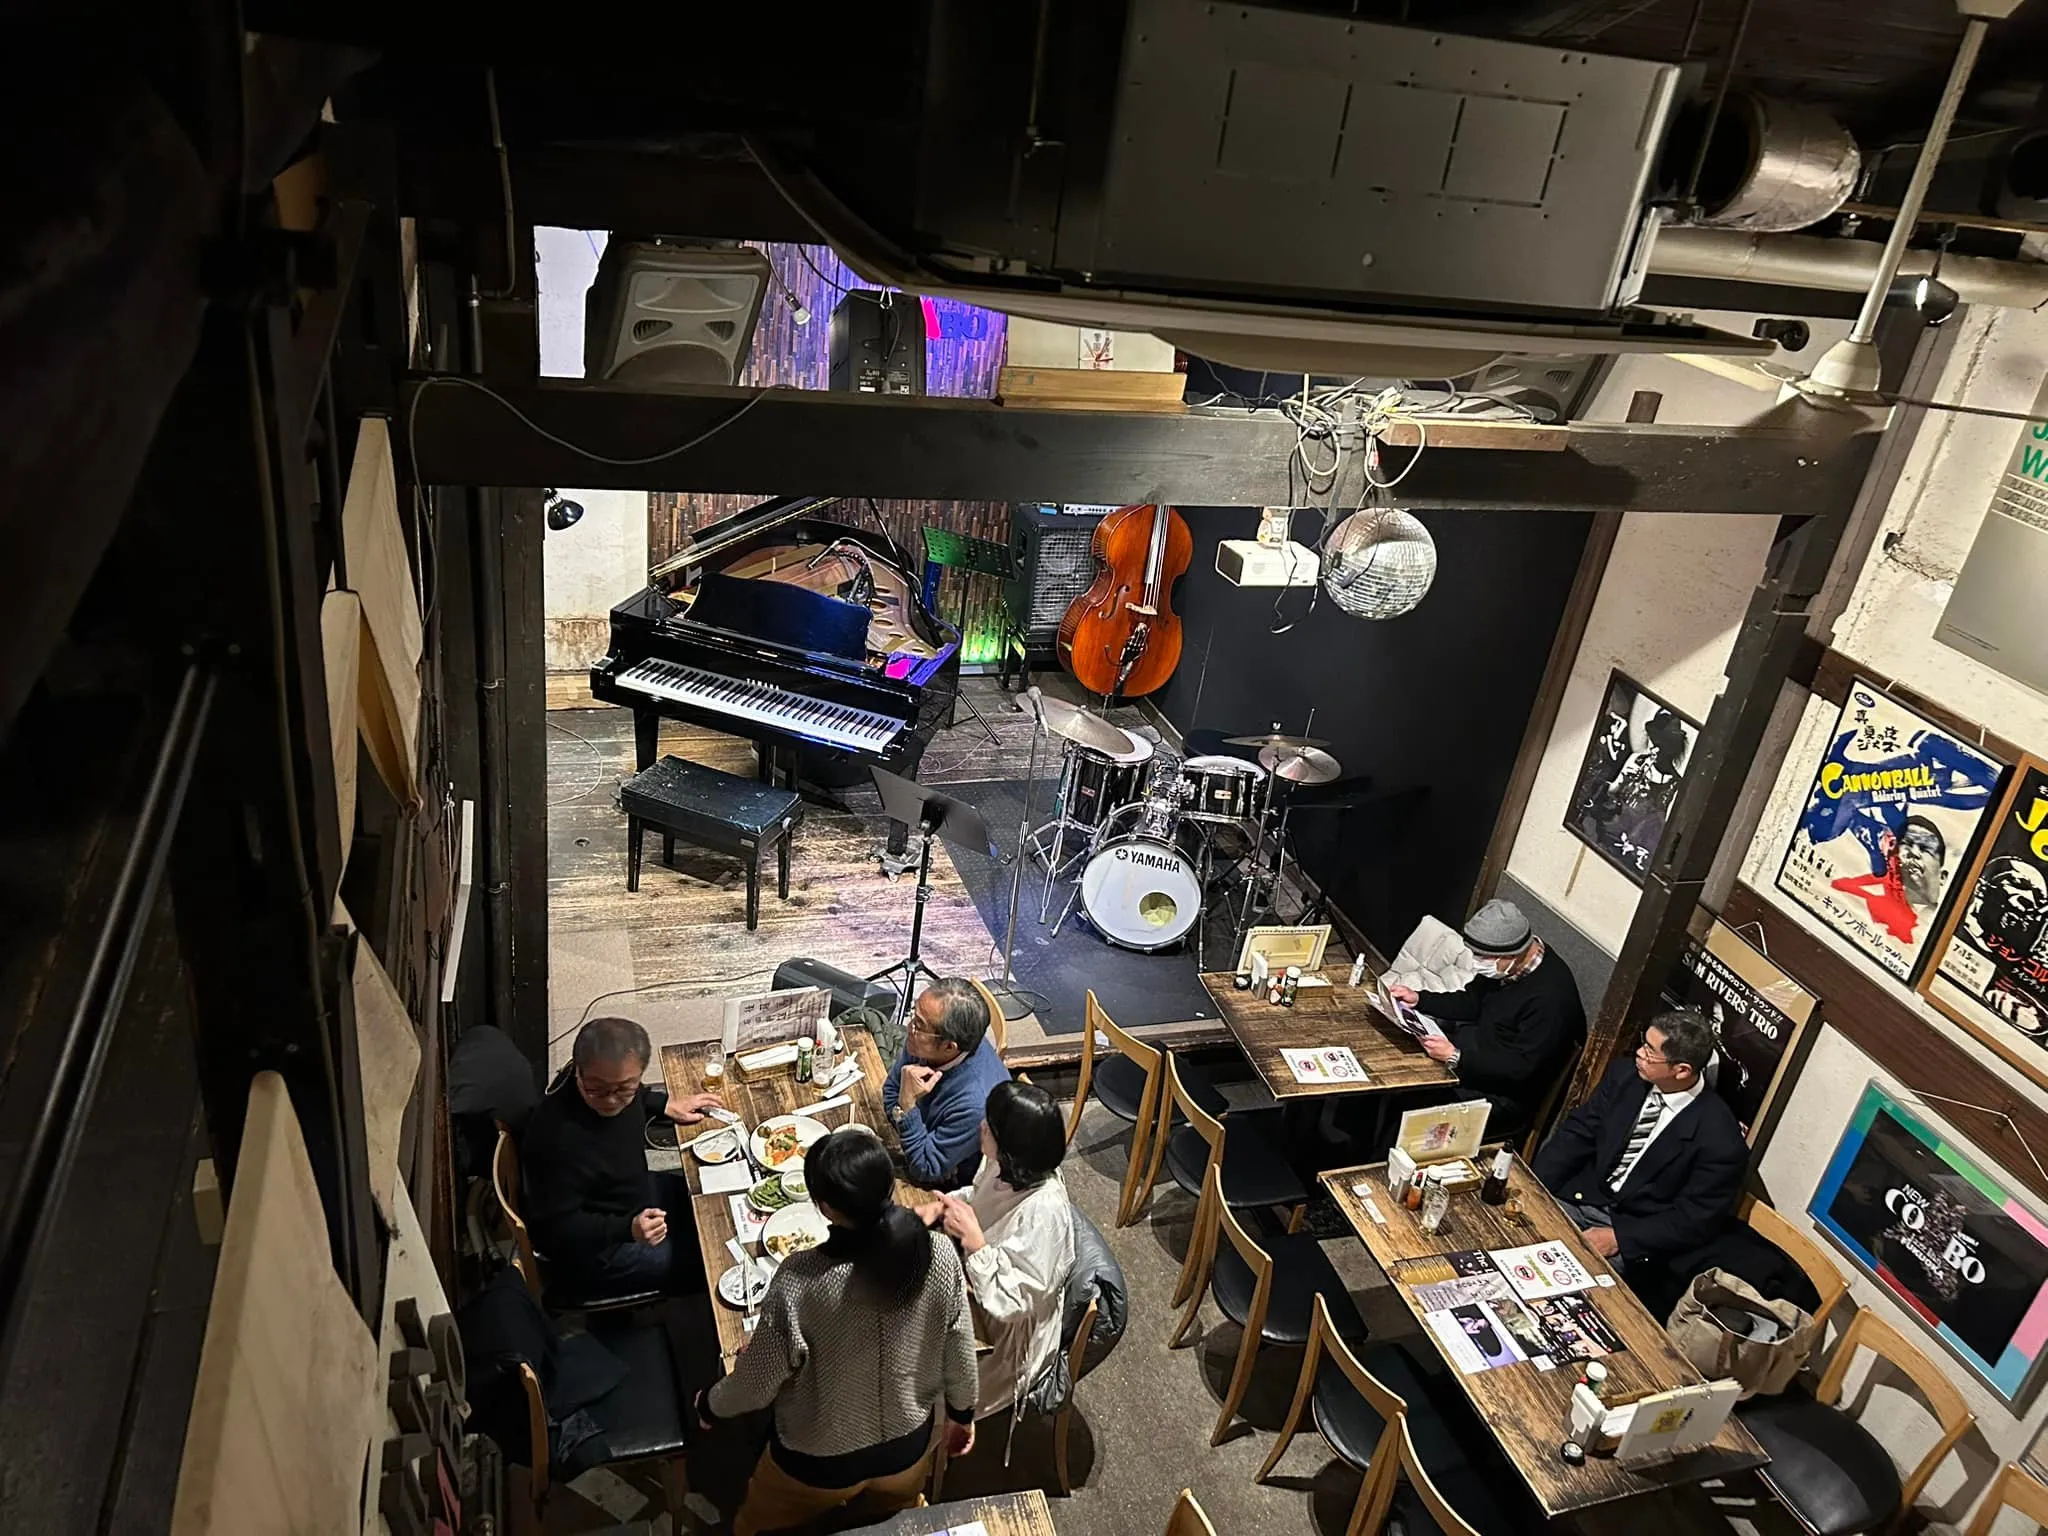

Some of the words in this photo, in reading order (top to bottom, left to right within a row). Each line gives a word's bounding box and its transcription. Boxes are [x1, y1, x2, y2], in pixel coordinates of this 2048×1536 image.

[1821, 761, 1936, 800] CANNONBALL
[1129, 849, 1181, 874] YAMAHA
[1704, 970, 1749, 1015] RIVERS
[1748, 1008, 1779, 1041] TRIO
[1902, 1184, 1931, 1209] NEW
